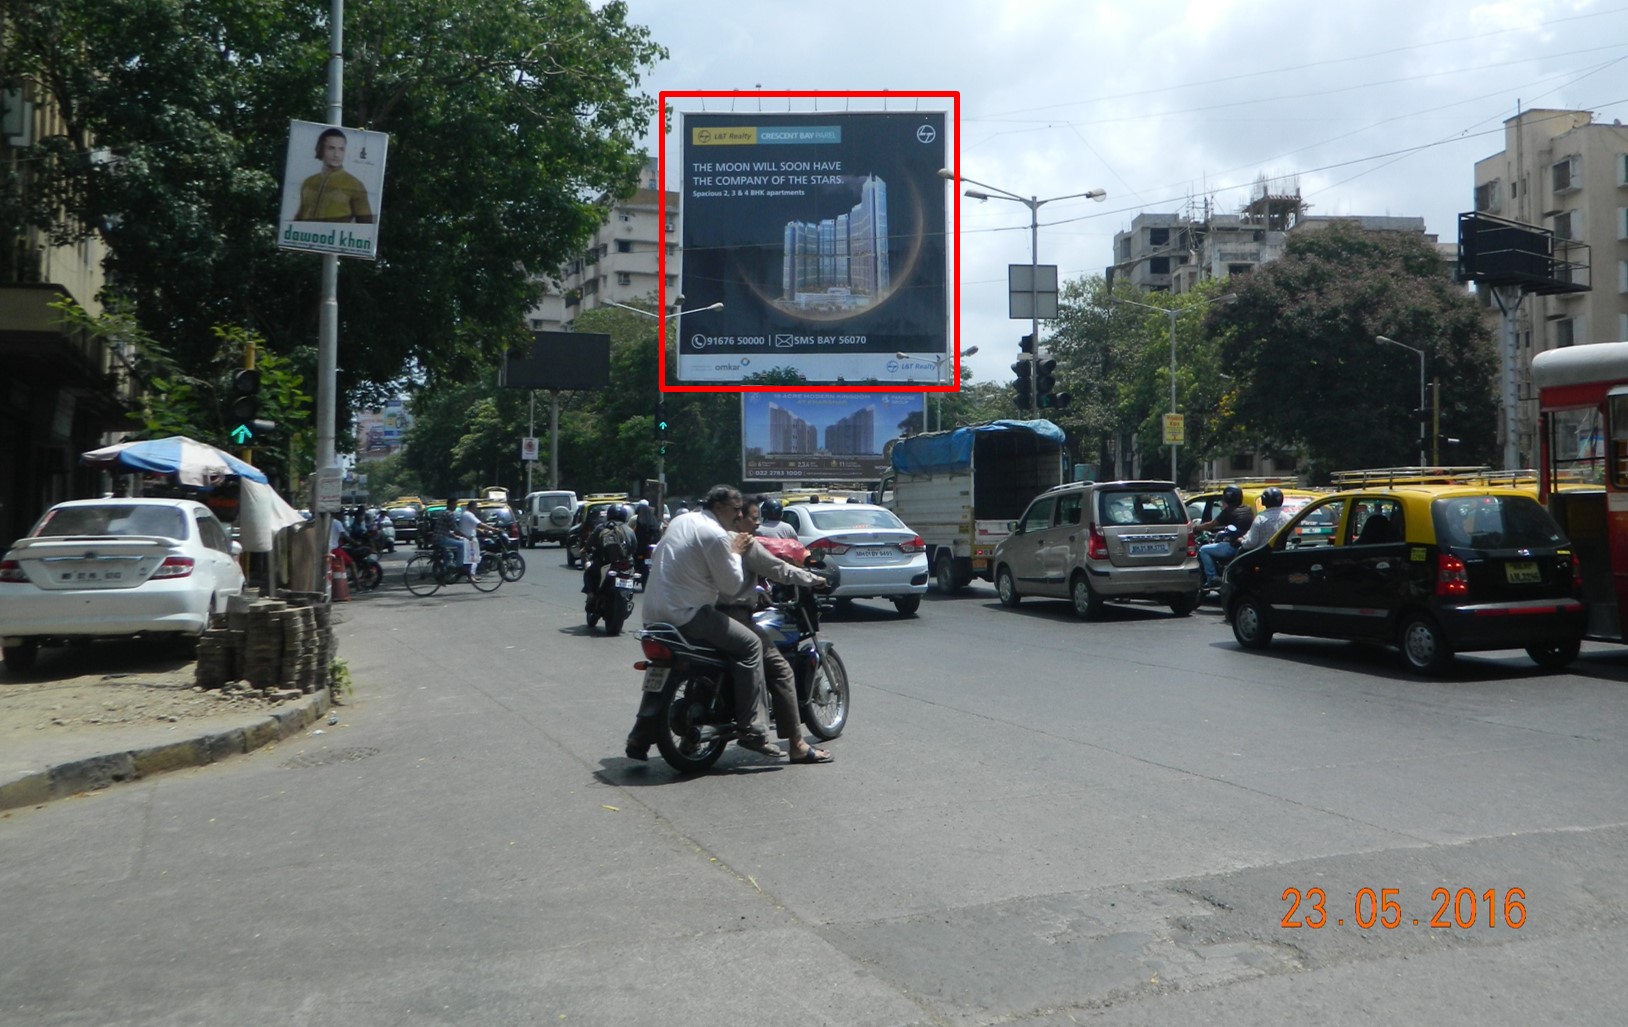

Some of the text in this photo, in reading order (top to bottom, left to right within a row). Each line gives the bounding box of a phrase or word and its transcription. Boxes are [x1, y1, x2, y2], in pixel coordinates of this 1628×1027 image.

[729, 133, 752, 141] Realty
[761, 132, 798, 140] CRESCENT
[693, 161, 841, 172] THE MOON WILL SOON HAVE
[693, 175, 844, 186] THE COMPANY OF THE STARS.
[692, 190, 722, 198] Spacious
[284, 224, 336, 245] dawood
[339, 230, 371, 249] khan
[707, 336, 765, 345] 91676 50000
[794, 335, 867, 345] SMS BAY 56070
[714, 363, 741, 371] omkar
[914, 363, 936, 371] Realty
